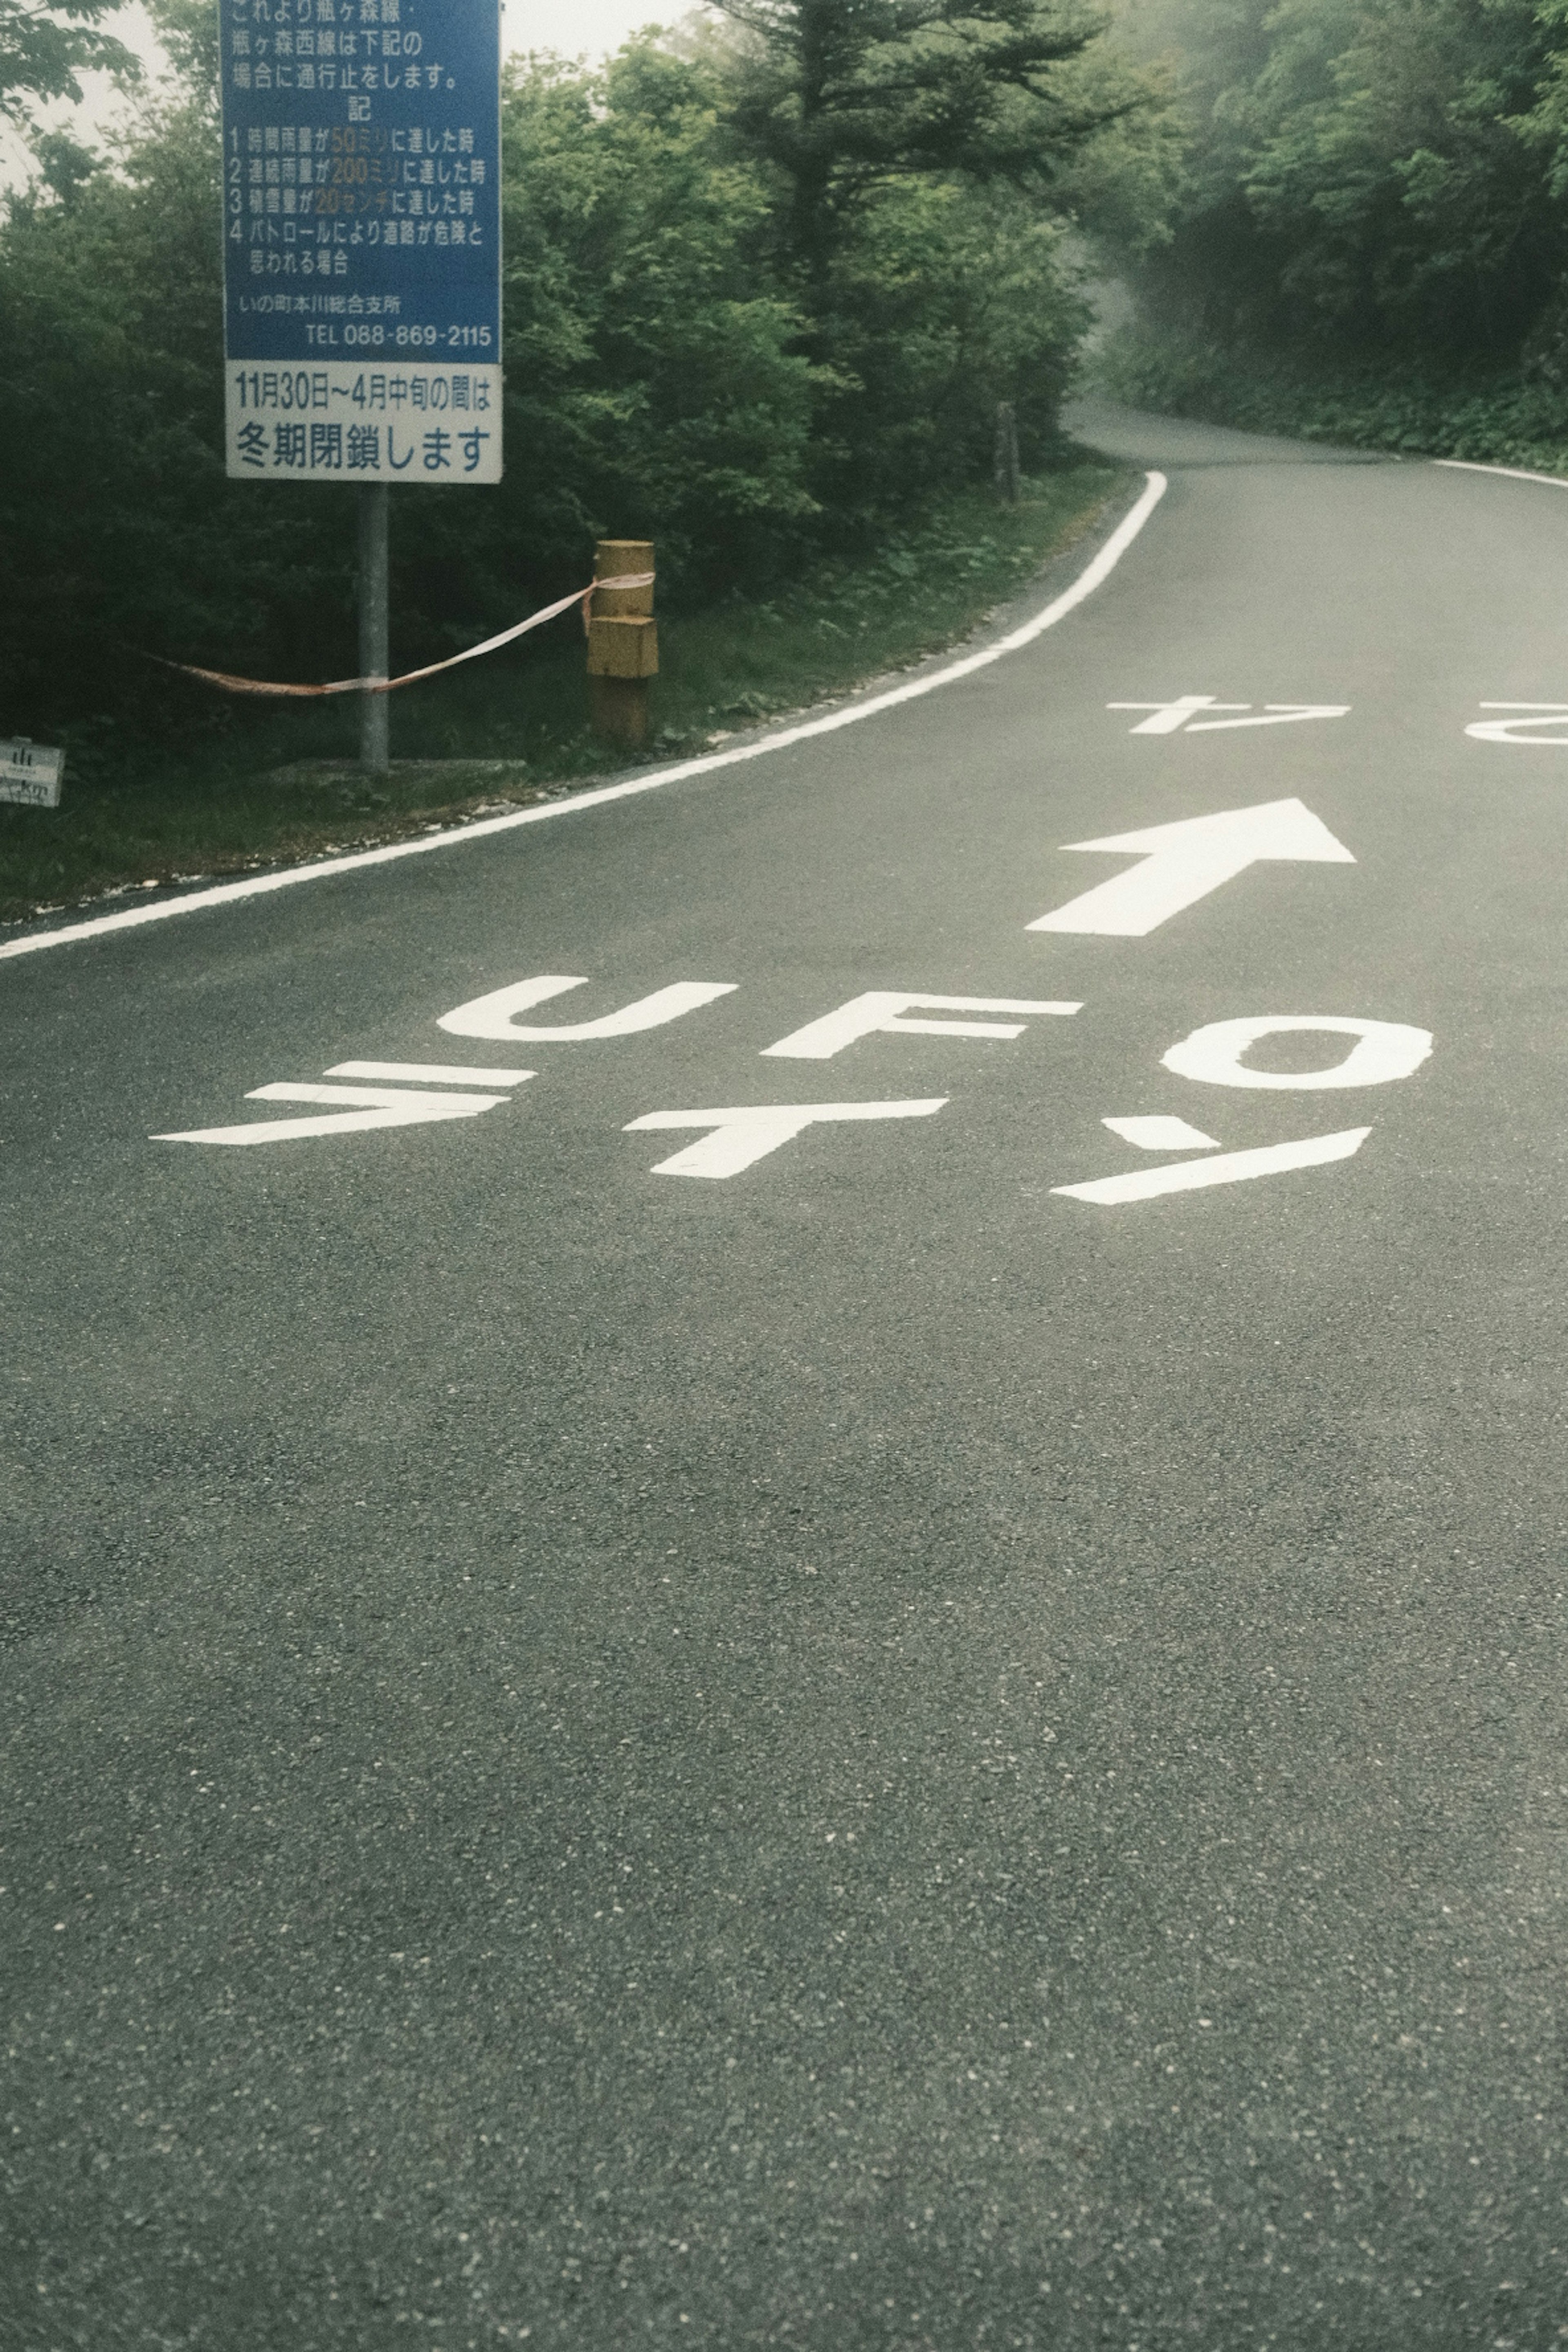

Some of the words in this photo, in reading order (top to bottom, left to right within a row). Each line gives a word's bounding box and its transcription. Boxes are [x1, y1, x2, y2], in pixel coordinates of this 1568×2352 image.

[348, 96, 371, 121] 記
[250, 249, 348, 275] 思われる場合
[306, 325, 338, 344] TEL
[344, 324, 492, 346] 088-869-2115
[237, 421, 490, 472] 冬期閉鎖します
[435, 975, 1435, 1091] UFO
[149, 1060, 1373, 1207] ライン
